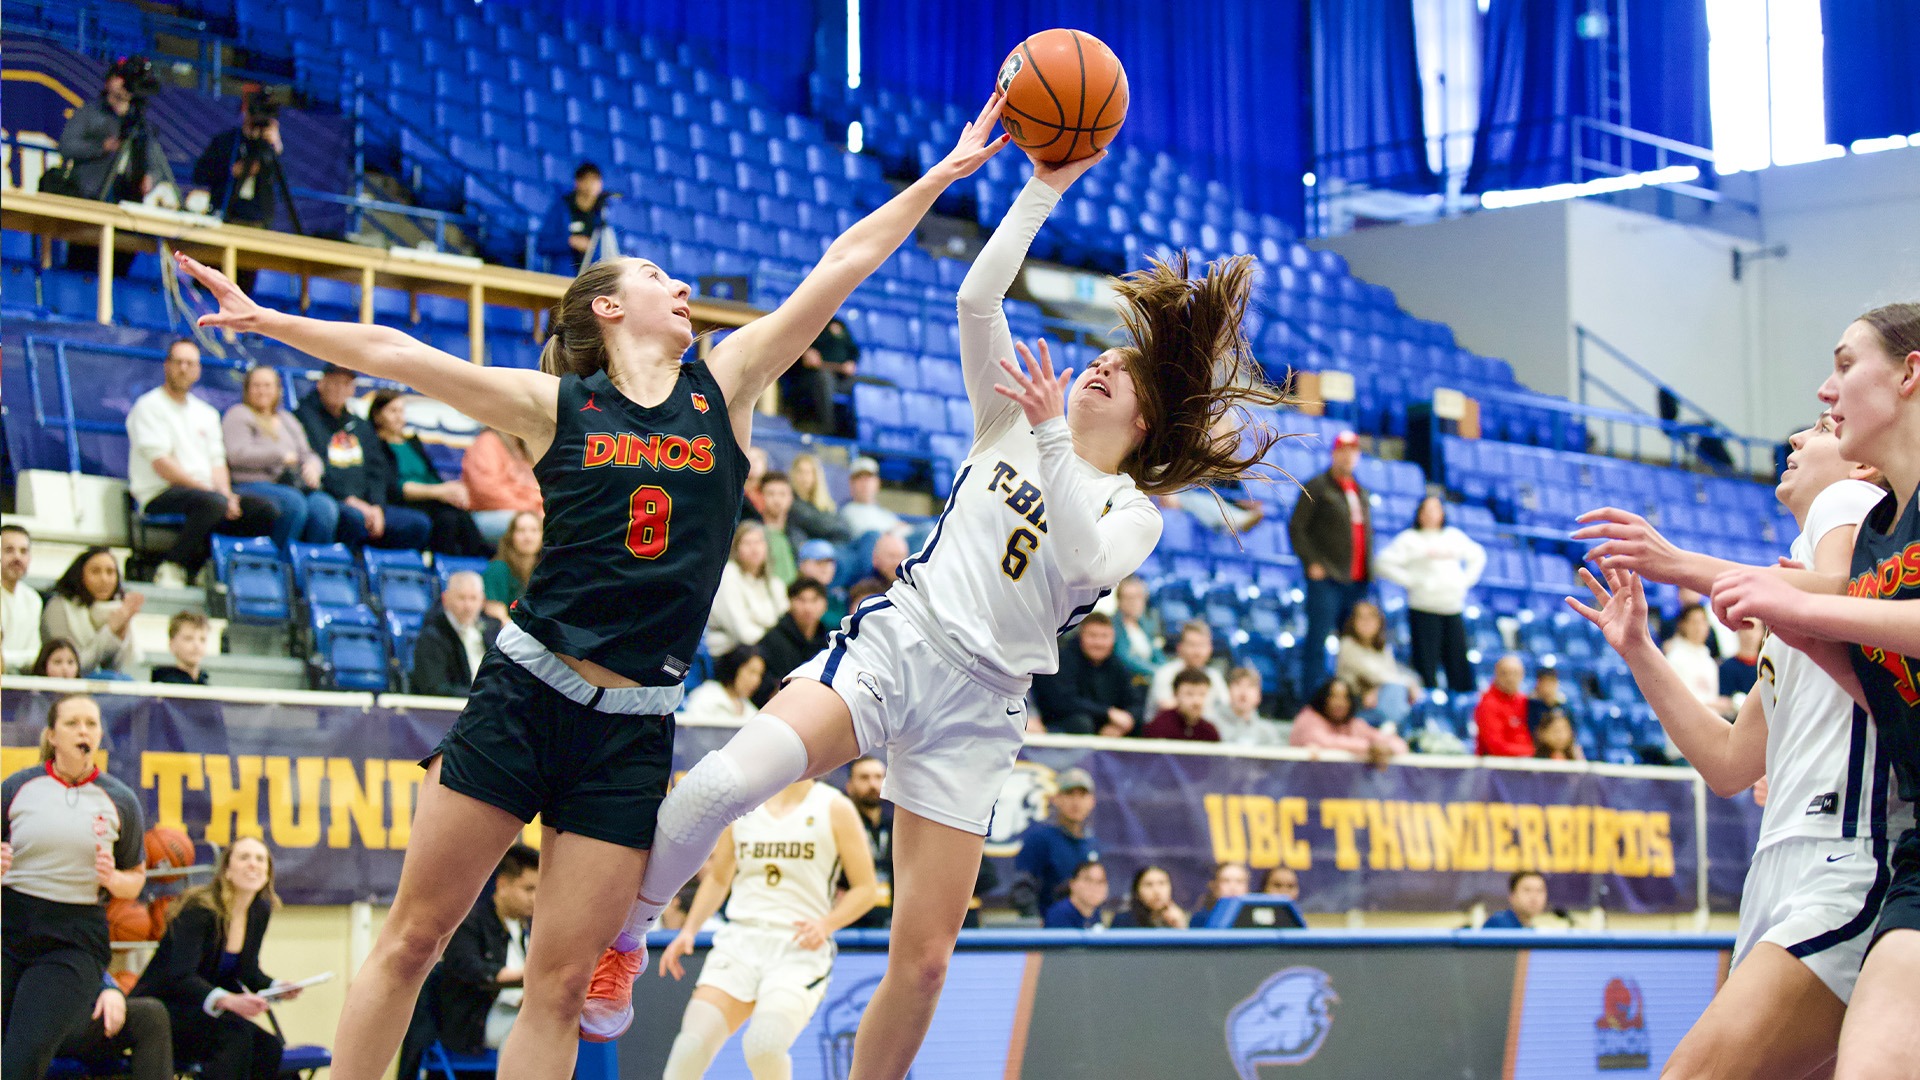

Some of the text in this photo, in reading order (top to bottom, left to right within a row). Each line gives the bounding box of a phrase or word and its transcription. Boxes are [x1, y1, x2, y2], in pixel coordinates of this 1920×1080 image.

[583, 432, 716, 474] DINOS
[625, 484, 672, 560] 8
[986, 460, 1048, 534] T-BI
[1001, 525, 1040, 582] 6
[739, 842, 815, 860] T-BIRDS
[1203, 794, 1675, 878] UBC THUNDERBIRDS
